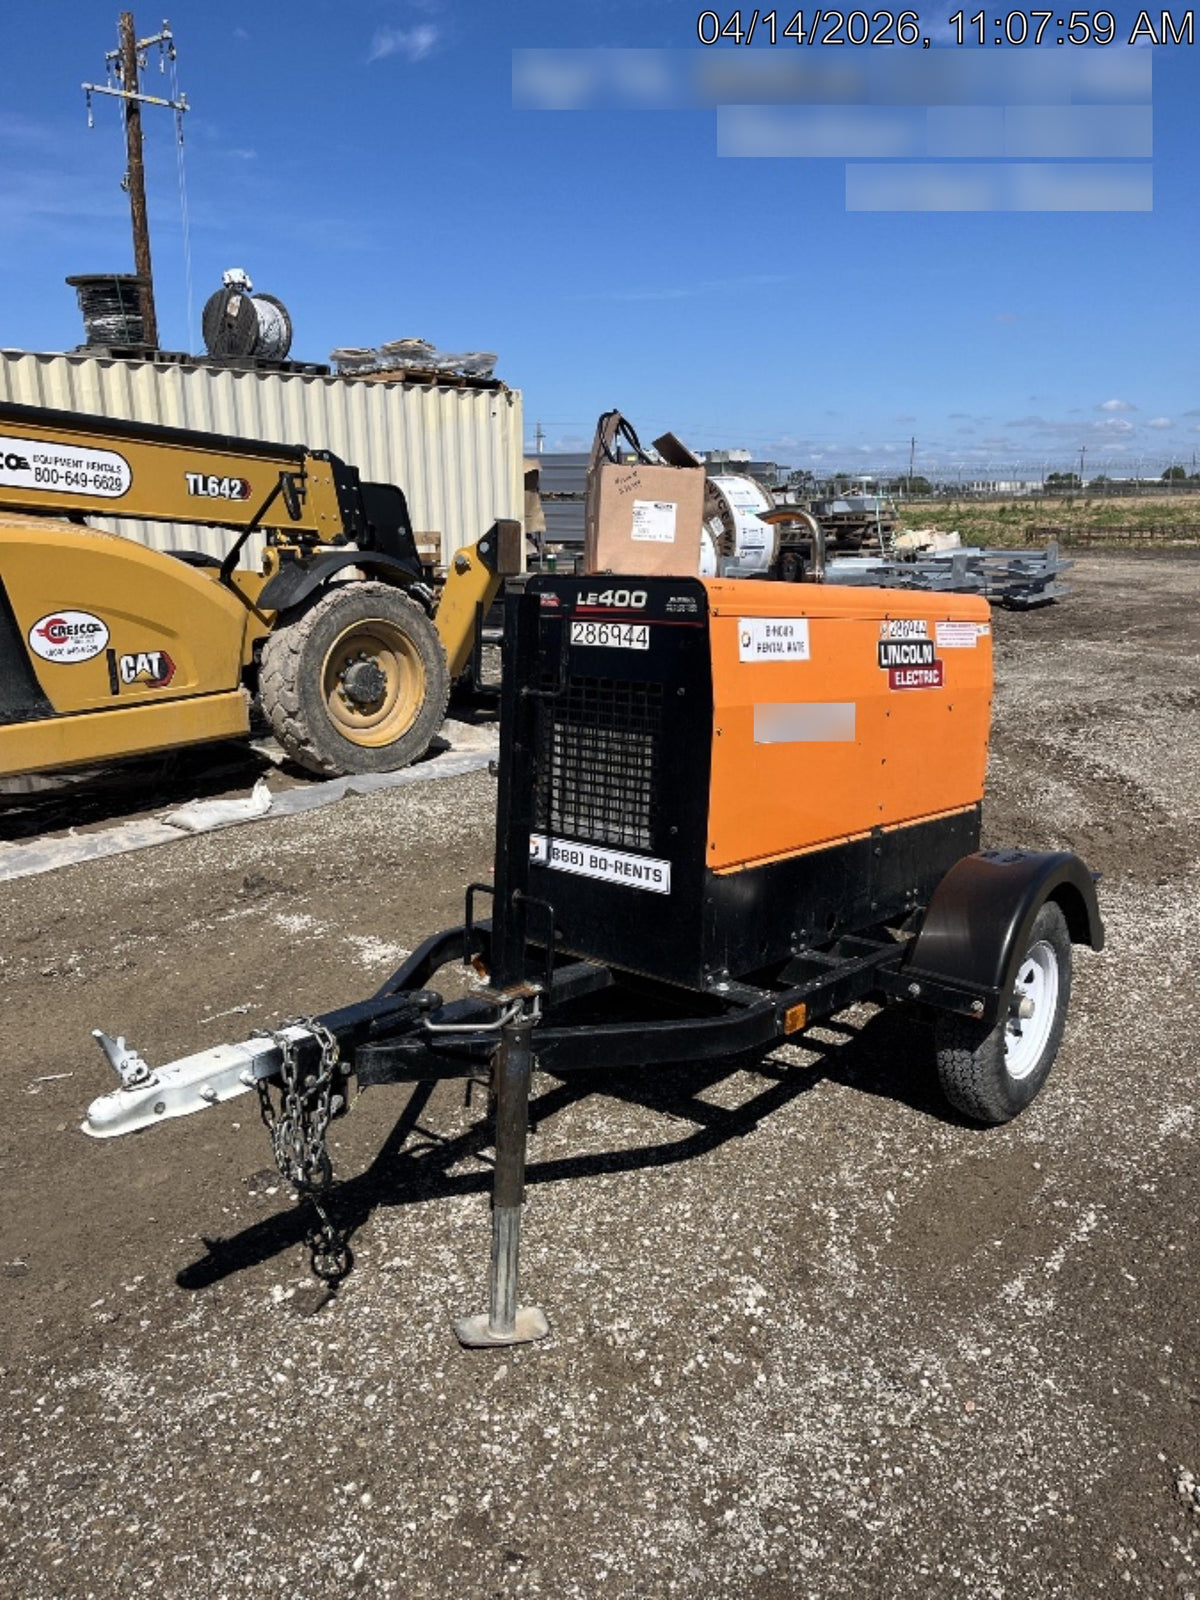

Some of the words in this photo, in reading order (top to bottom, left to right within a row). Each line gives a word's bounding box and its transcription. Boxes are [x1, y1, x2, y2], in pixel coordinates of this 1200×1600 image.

[33, 454, 84, 469] EQUIPMENT
[86, 461, 122, 474] RENTALS
[35, 467, 122, 491] 800-649-6629
[186, 472, 243, 499] TL642
[577, 589, 648, 608] LE400
[50, 623, 102, 637] CRESCO
[572, 623, 649, 648] 286944
[880, 644, 933, 666] LINCOLN
[120, 652, 161, 683] CAT
[894, 669, 941, 686] ELECTRIC
